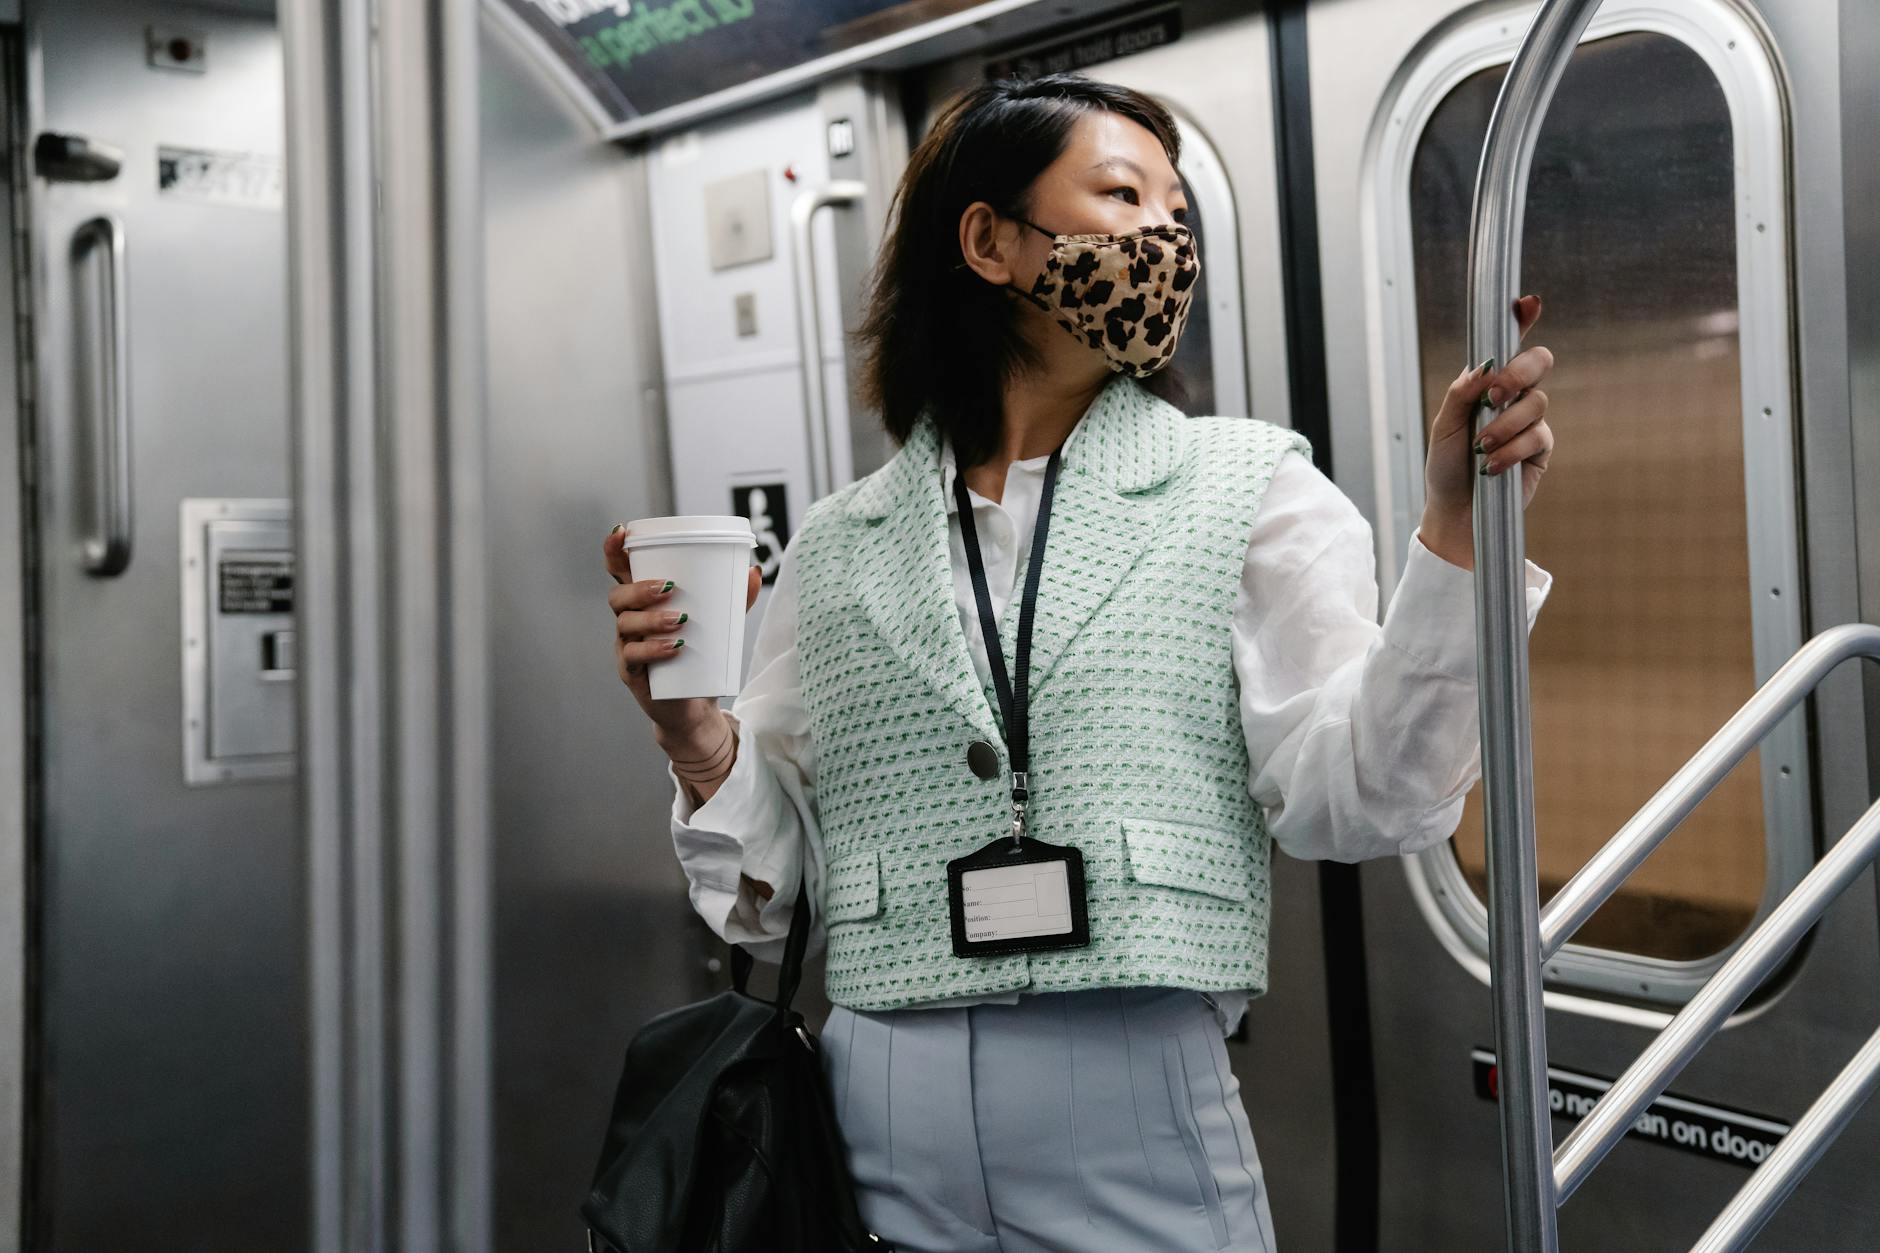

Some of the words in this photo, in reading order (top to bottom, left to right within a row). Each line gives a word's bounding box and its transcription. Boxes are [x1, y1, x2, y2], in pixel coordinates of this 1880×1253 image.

[1114, 24, 1167, 54] doors
[1549, 1088, 1565, 1111] o
[1566, 1093, 1603, 1116] no
[1633, 1112, 1669, 1140] an
[1672, 1120, 1708, 1150] on
